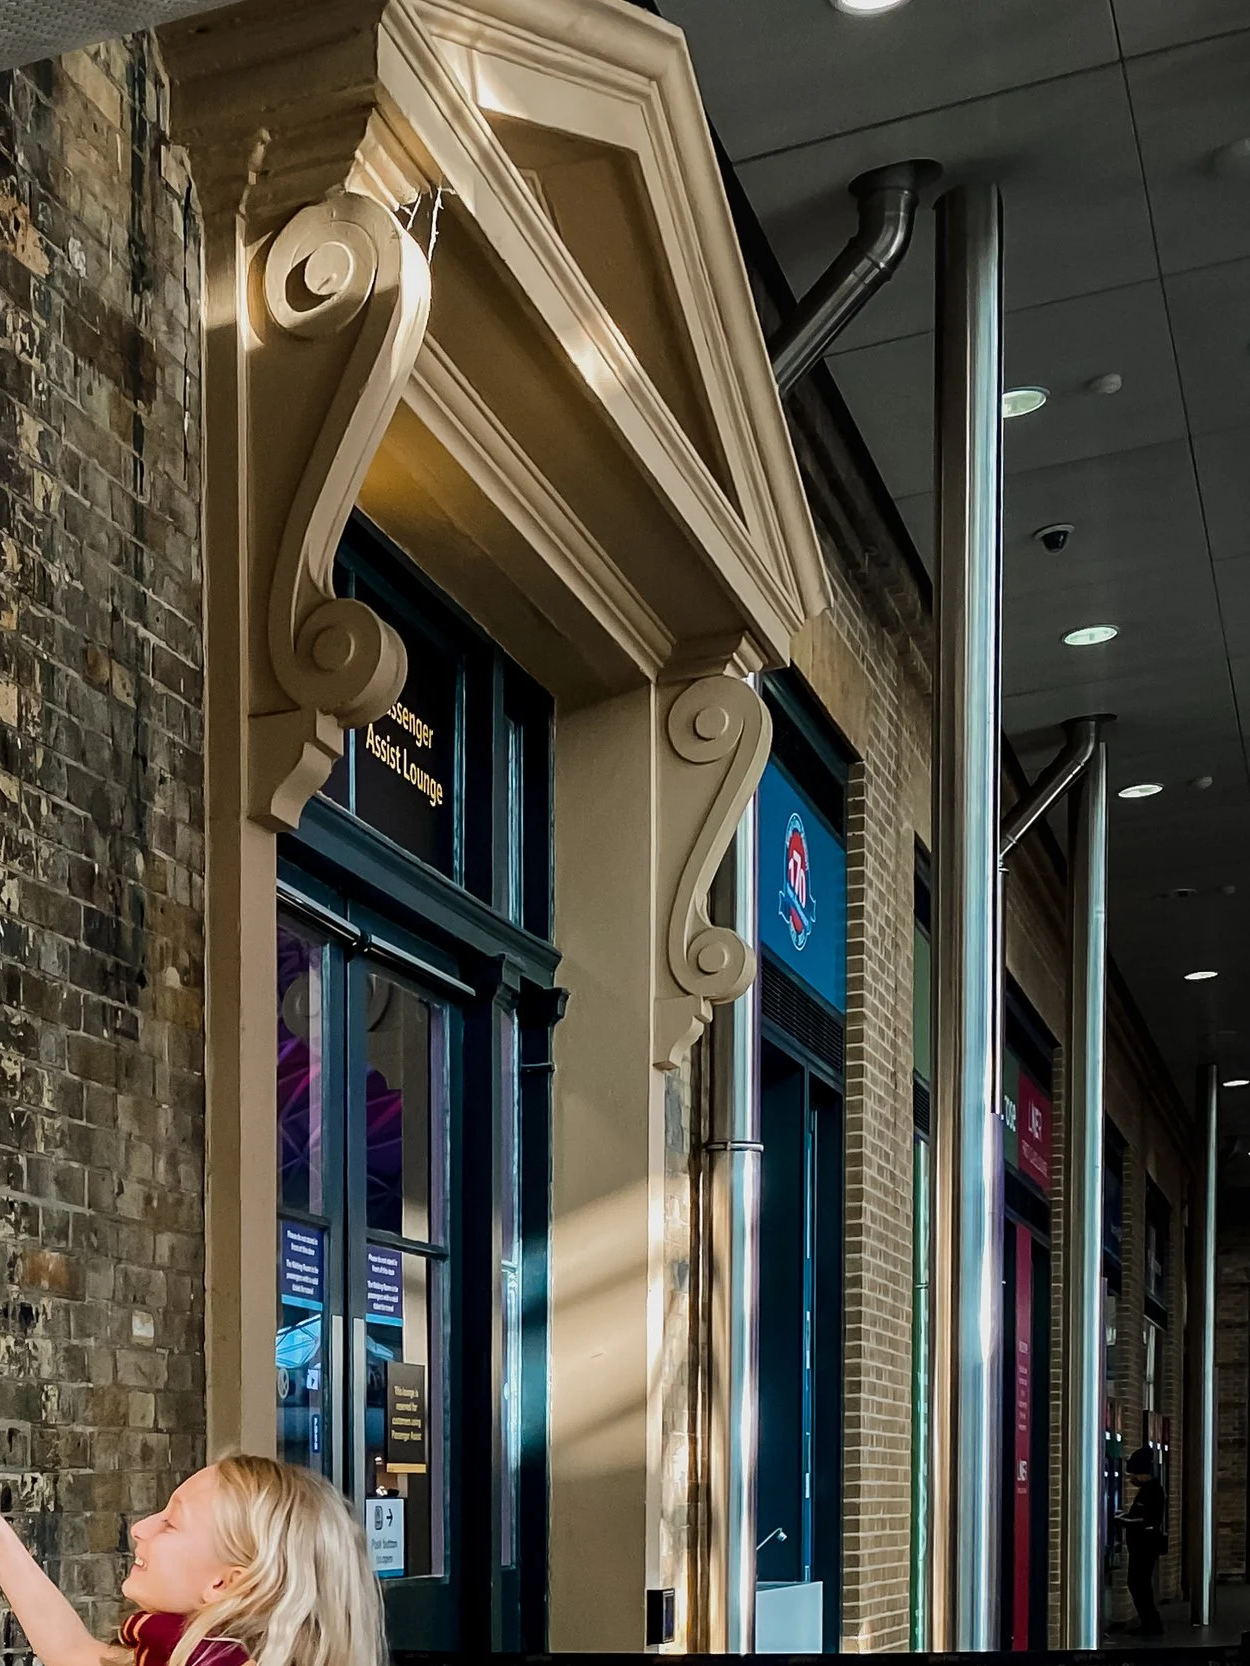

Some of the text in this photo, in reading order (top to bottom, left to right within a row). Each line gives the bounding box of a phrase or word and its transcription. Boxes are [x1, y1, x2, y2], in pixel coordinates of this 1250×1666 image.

[387, 702, 434, 749] ssenger
[366, 722, 443, 807] Assist Lounge
